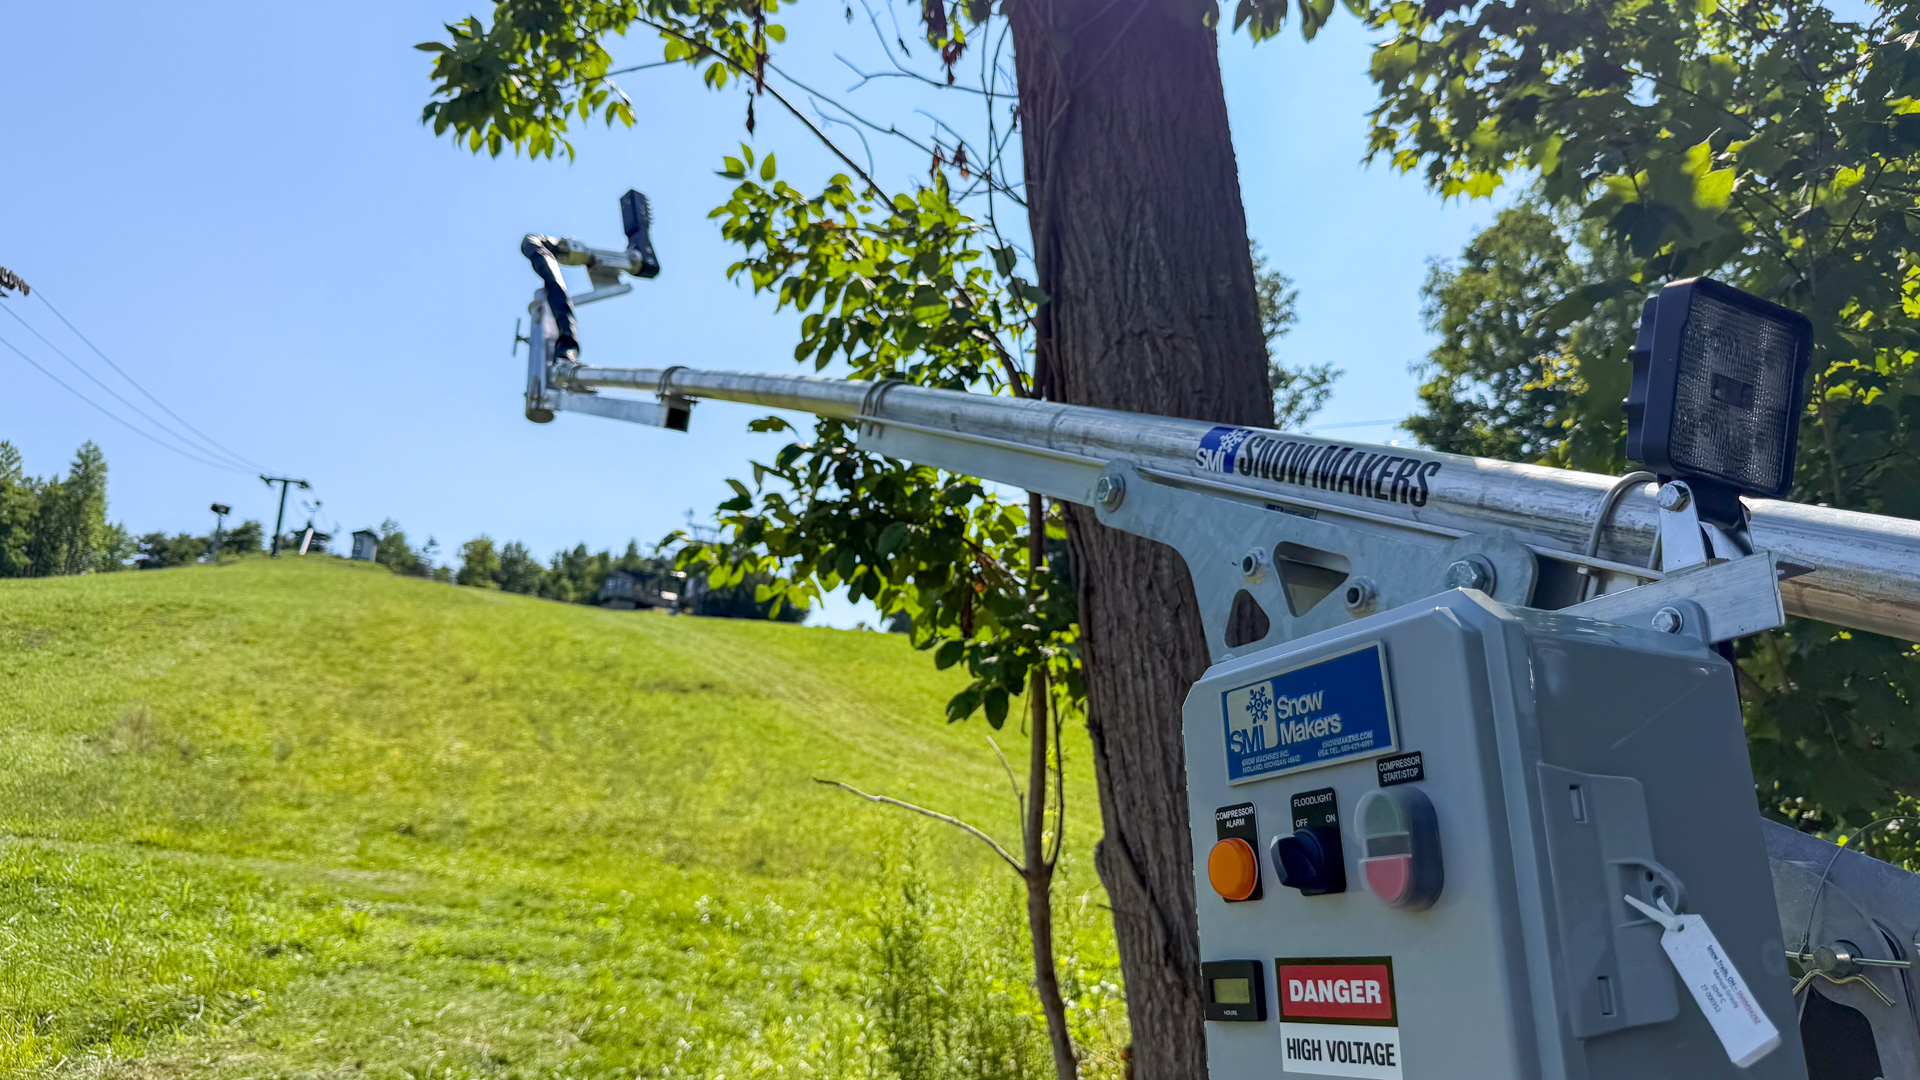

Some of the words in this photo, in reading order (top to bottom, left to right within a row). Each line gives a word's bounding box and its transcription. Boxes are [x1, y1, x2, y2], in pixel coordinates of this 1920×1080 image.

[1195, 448, 1225, 473] SMI
[1277, 689, 1324, 719] Snow
[1280, 713, 1342, 746] Makers
[1230, 724, 1264, 754] SMI
[1322, 730, 1373, 748] SNOWMAKERS.COM
[1241, 758, 1255, 767] SNOW
[1256, 752, 1280, 763] MACHINES
[1317, 748, 1329, 757] USA
[1264, 758, 1287, 769] MICHIGAN
[1379, 755, 1421, 771] COMPRESSOR
[1383, 768, 1419, 782] START/STOP
[1293, 792, 1333, 808] FLOODLIGHT
[1215, 806, 1254, 820] COMPRESSOR
[1295, 818, 1308, 828] OFF
[1325, 814, 1336, 823] ON
[1225, 818, 1245, 829] ALARM
[1707, 944, 1718, 960] Snow
[1288, 979, 1382, 1004] DANGER
[1712, 968, 1727, 990] Manual
[1725, 989, 1739, 1009] Grizzly
[1286, 1038, 1322, 1061] HIGH
[1325, 1040, 1396, 1067] VOLTAGE
